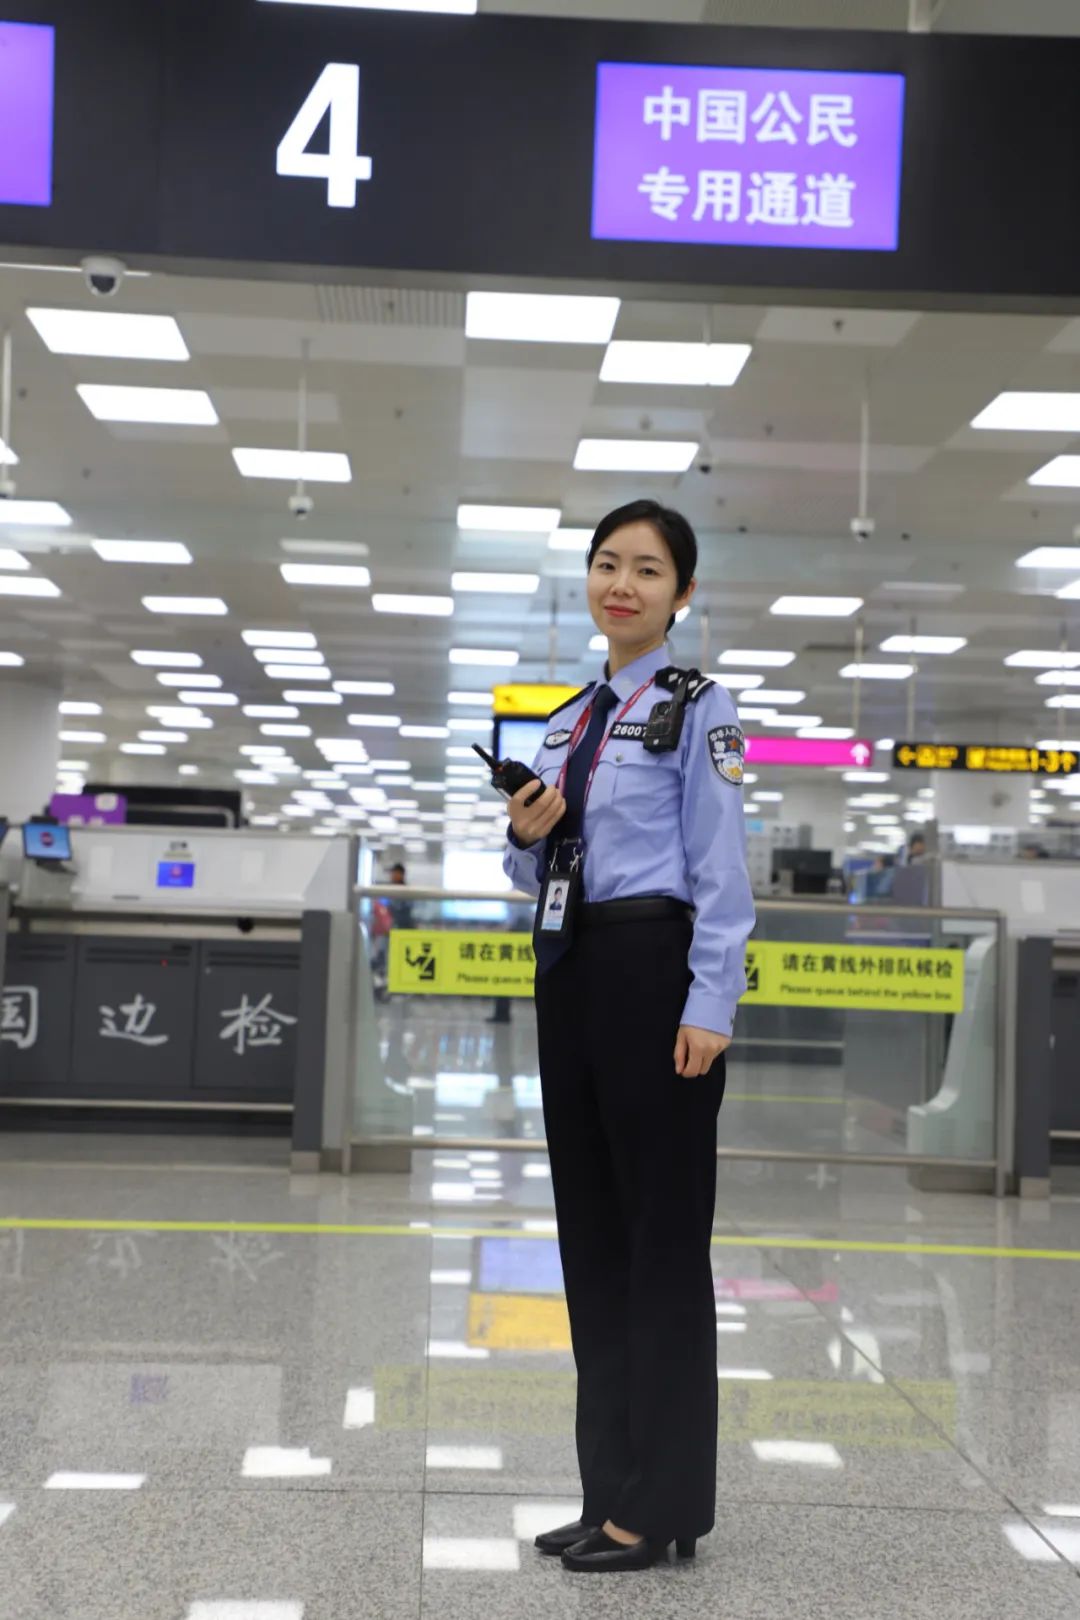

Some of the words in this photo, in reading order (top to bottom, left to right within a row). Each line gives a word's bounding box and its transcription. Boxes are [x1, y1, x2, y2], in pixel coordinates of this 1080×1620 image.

[276, 62, 372, 208] 4
[643, 85, 857, 147] 中国公民
[637, 166, 856, 227] 专用通道
[780, 984, 812, 995] Please
[815, 987, 844, 997] queue
[847, 986, 880, 997] behind
[884, 988, 899, 998] the
[901, 989, 932, 1000] yellow
[935, 991, 952, 1000] line
[782, 953, 953, 979] 请在黄线外排队候检
